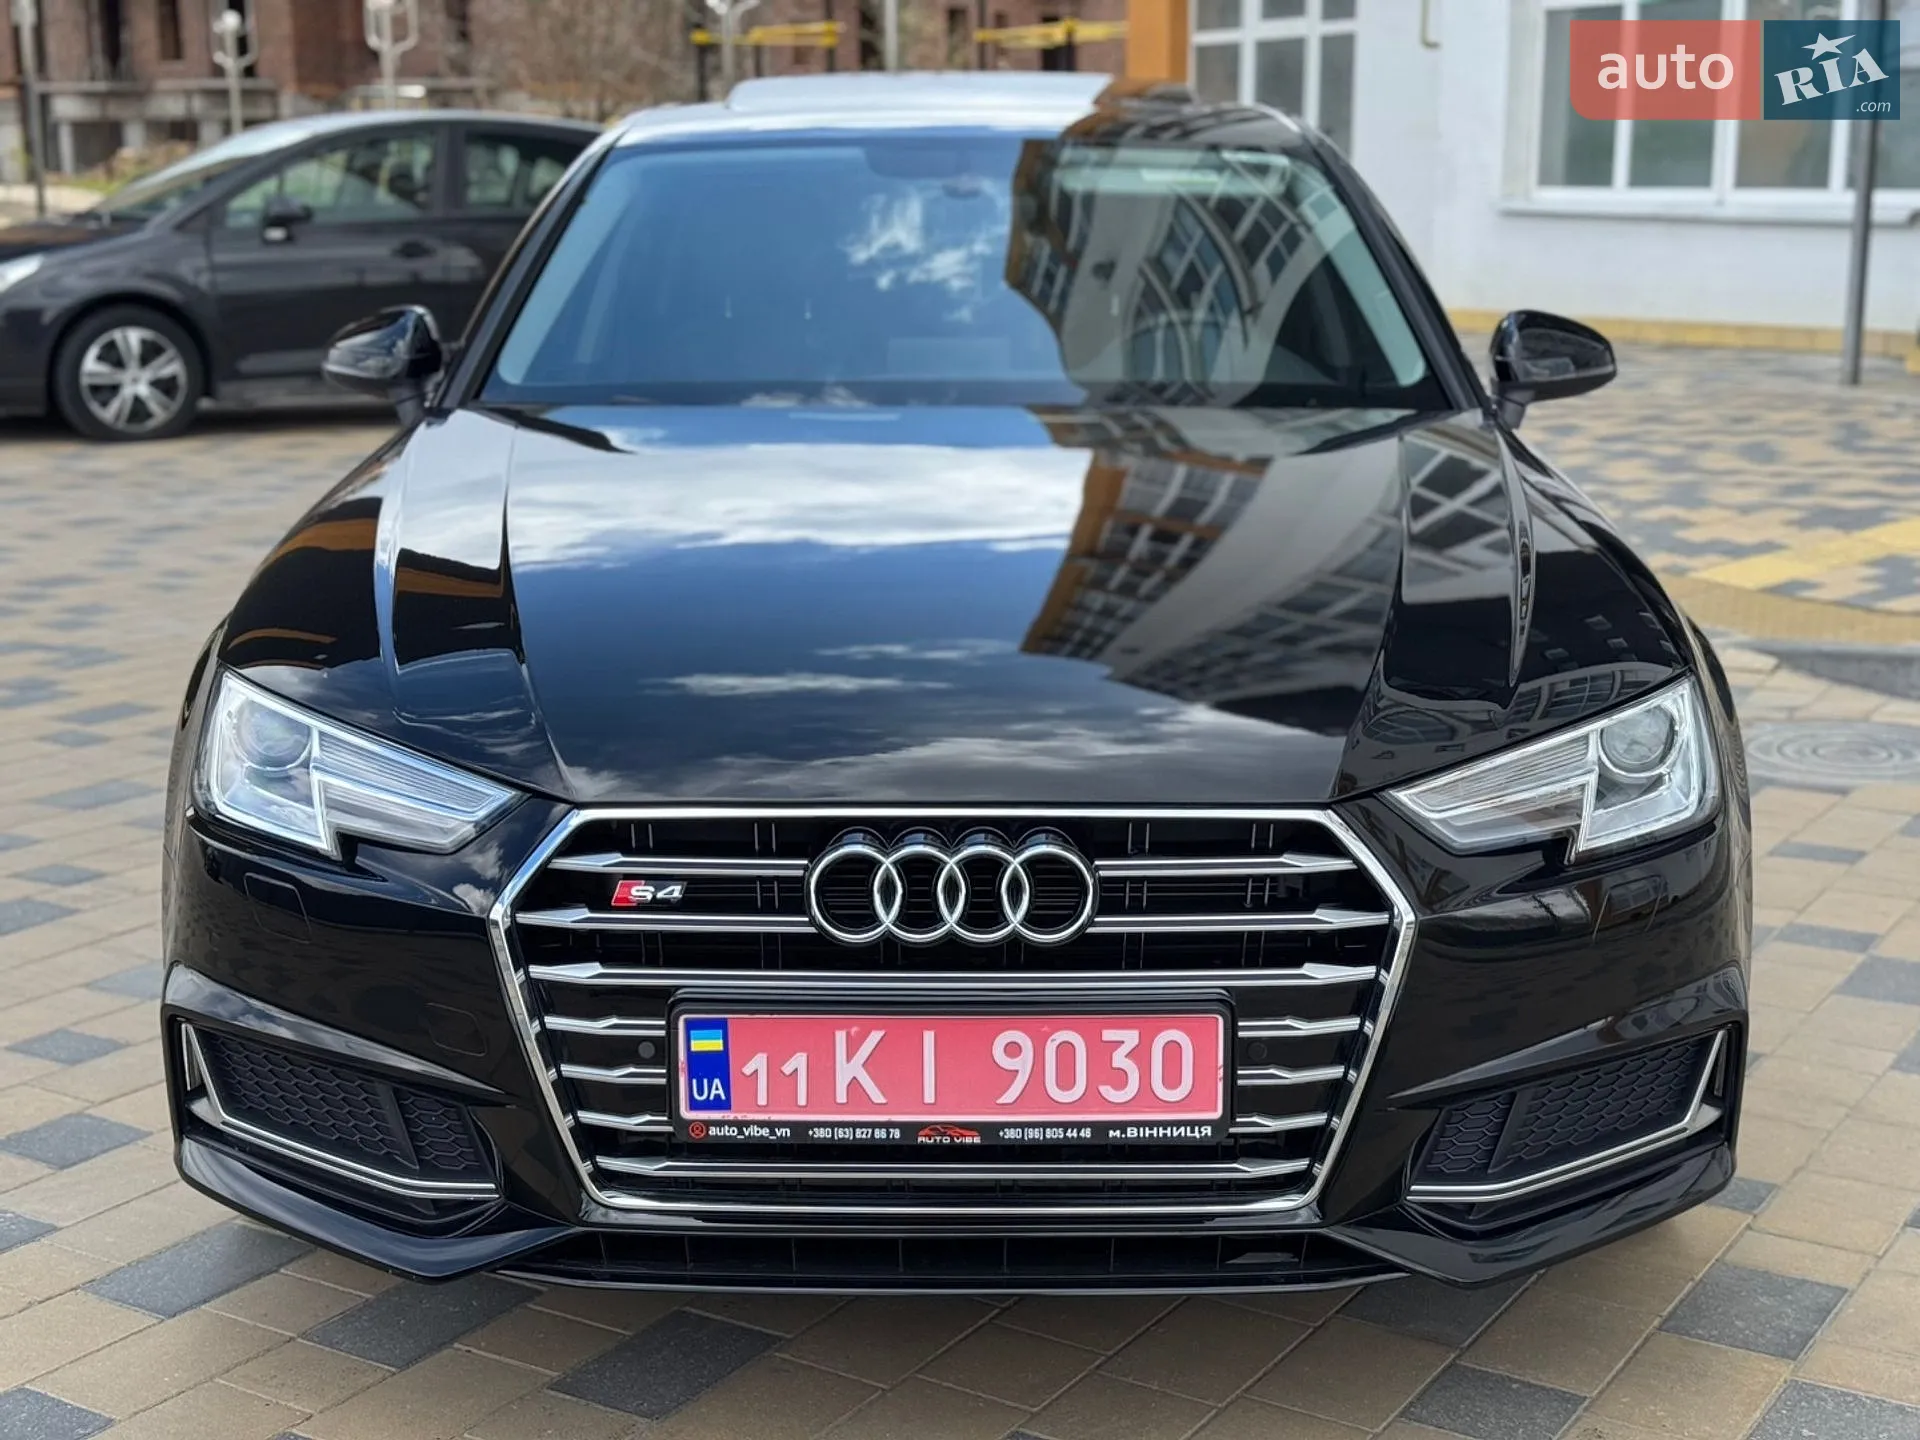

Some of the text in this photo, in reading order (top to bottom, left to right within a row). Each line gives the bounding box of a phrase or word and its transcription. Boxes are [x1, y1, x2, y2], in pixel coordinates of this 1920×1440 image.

[629, 885, 683, 903] S4
[992, 1029, 1194, 1104] 9030
[692, 1078, 726, 1101] UA
[708, 1124, 791, 1139] auto_vibe_vn
[808, 1127, 832, 1138] +380
[834, 1127, 853, 1140] (63)
[855, 1127, 872, 1139] 827
[999, 1127, 1022, 1139] +380
[1065, 1128, 1077, 1138] 44
[1108, 1125, 1212, 1139] м.ВІННИЦЯ
[917, 1135, 981, 1144] AUTO VIBE
